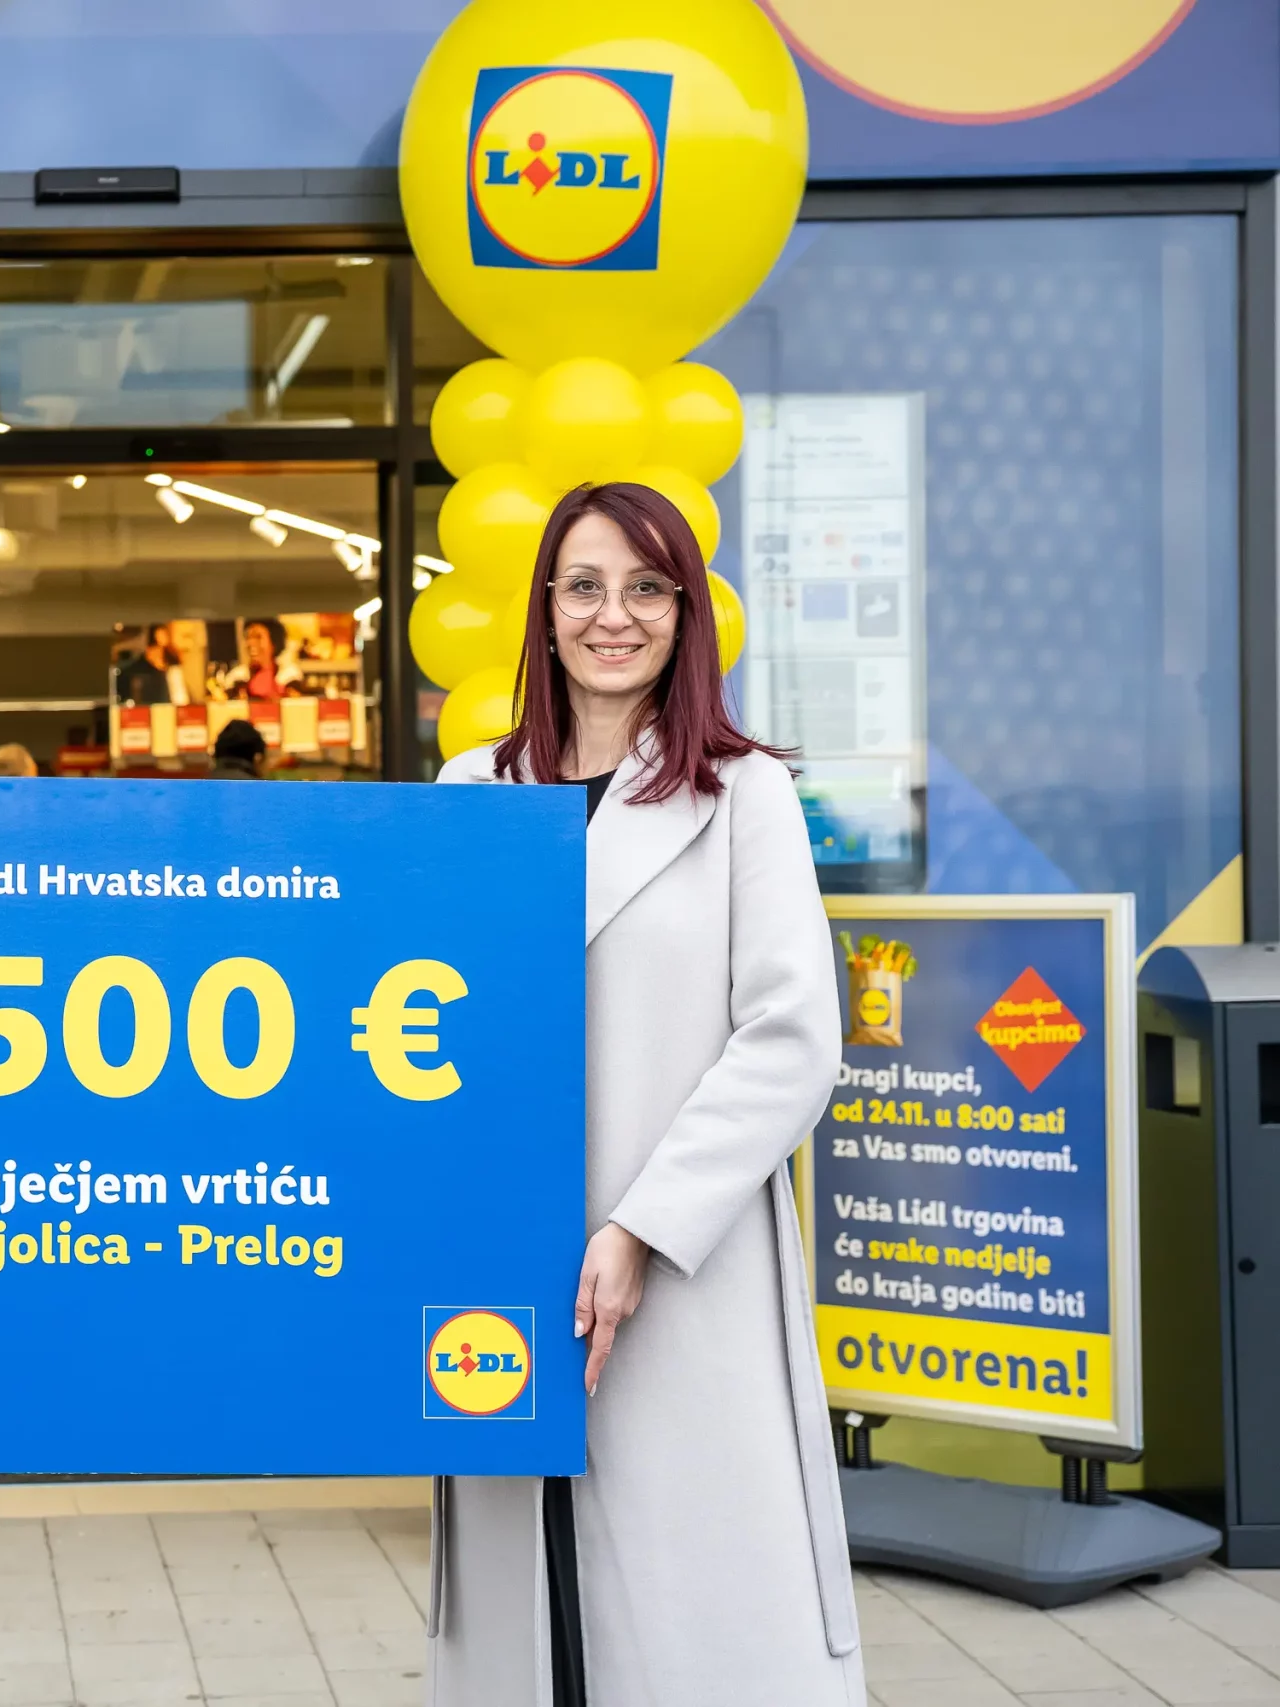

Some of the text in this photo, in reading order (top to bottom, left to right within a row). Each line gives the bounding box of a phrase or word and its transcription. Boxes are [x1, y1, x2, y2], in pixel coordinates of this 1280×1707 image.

[38, 863, 207, 898] Hrvatska
[216, 866, 341, 899] donira
[351, 958, 470, 1102] €
[980, 1018, 1082, 1051] kupcima
[836, 1063, 982, 1096] Dragi kupci,
[832, 1099, 1066, 1134] od 24.11. u 8:00 sati
[832, 1135, 1079, 1173] za Vas smo otvoreni.
[181, 1161, 331, 1206] vrtiću
[833, 1194, 1065, 1237] Vaša Lidl trgovina
[145, 1243, 163, 1252] -
[179, 1224, 343, 1278] Prelog
[834, 1232, 1051, 1279] će svake nedjelje
[835, 1270, 1086, 1318] do kraja godine biti
[836, 1332, 1088, 1398] otvorena!
